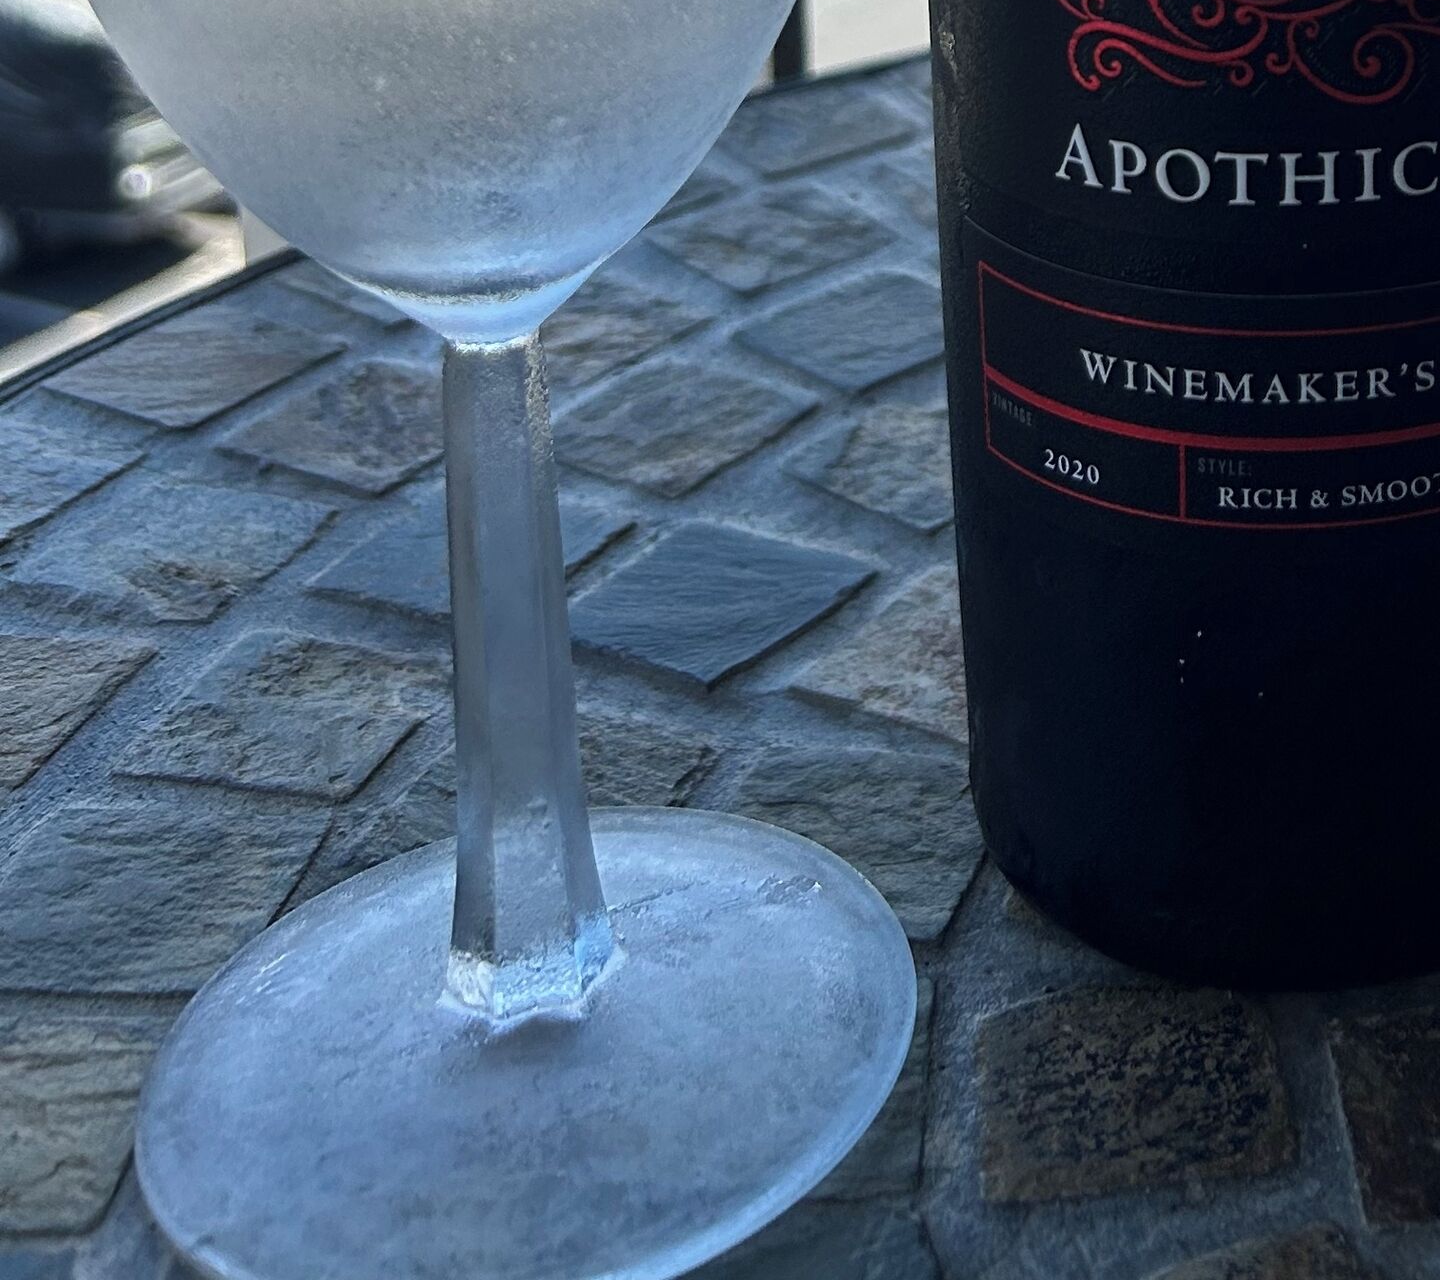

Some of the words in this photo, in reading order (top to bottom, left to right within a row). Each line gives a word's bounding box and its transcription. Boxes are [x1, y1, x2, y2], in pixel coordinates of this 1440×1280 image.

[1054, 122, 1439, 208] APOTHIC
[1079, 347, 1437, 406] WINEMAKER'S
[1042, 448, 1101, 486] 2020
[1217, 485, 1299, 510] RICH
[1309, 489, 1330, 509] &
